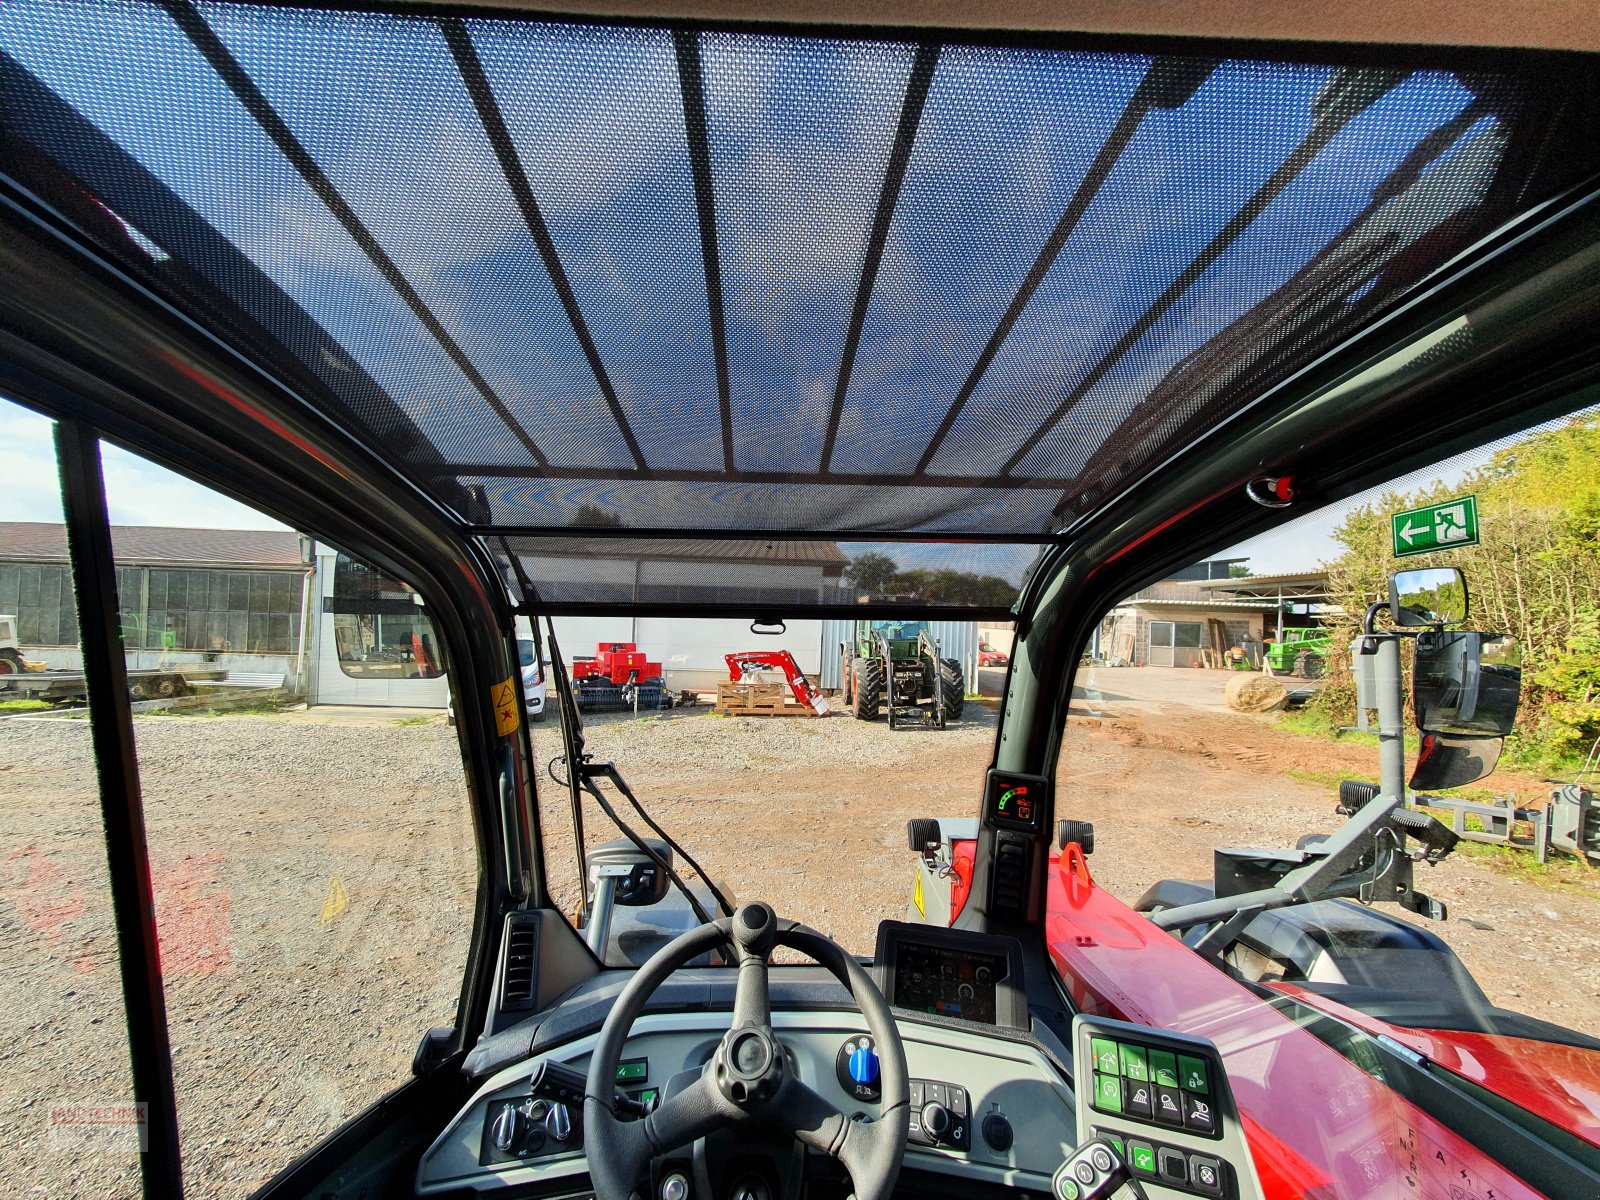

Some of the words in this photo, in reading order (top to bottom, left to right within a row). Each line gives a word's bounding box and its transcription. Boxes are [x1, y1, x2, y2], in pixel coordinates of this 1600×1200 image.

[1408, 1128, 1415, 1139] F
[1399, 1137, 1407, 1150] N
[1436, 1150, 1447, 1166] A
[1409, 1161, 1418, 1175] R
[1066, 1184, 1075, 1196] A
